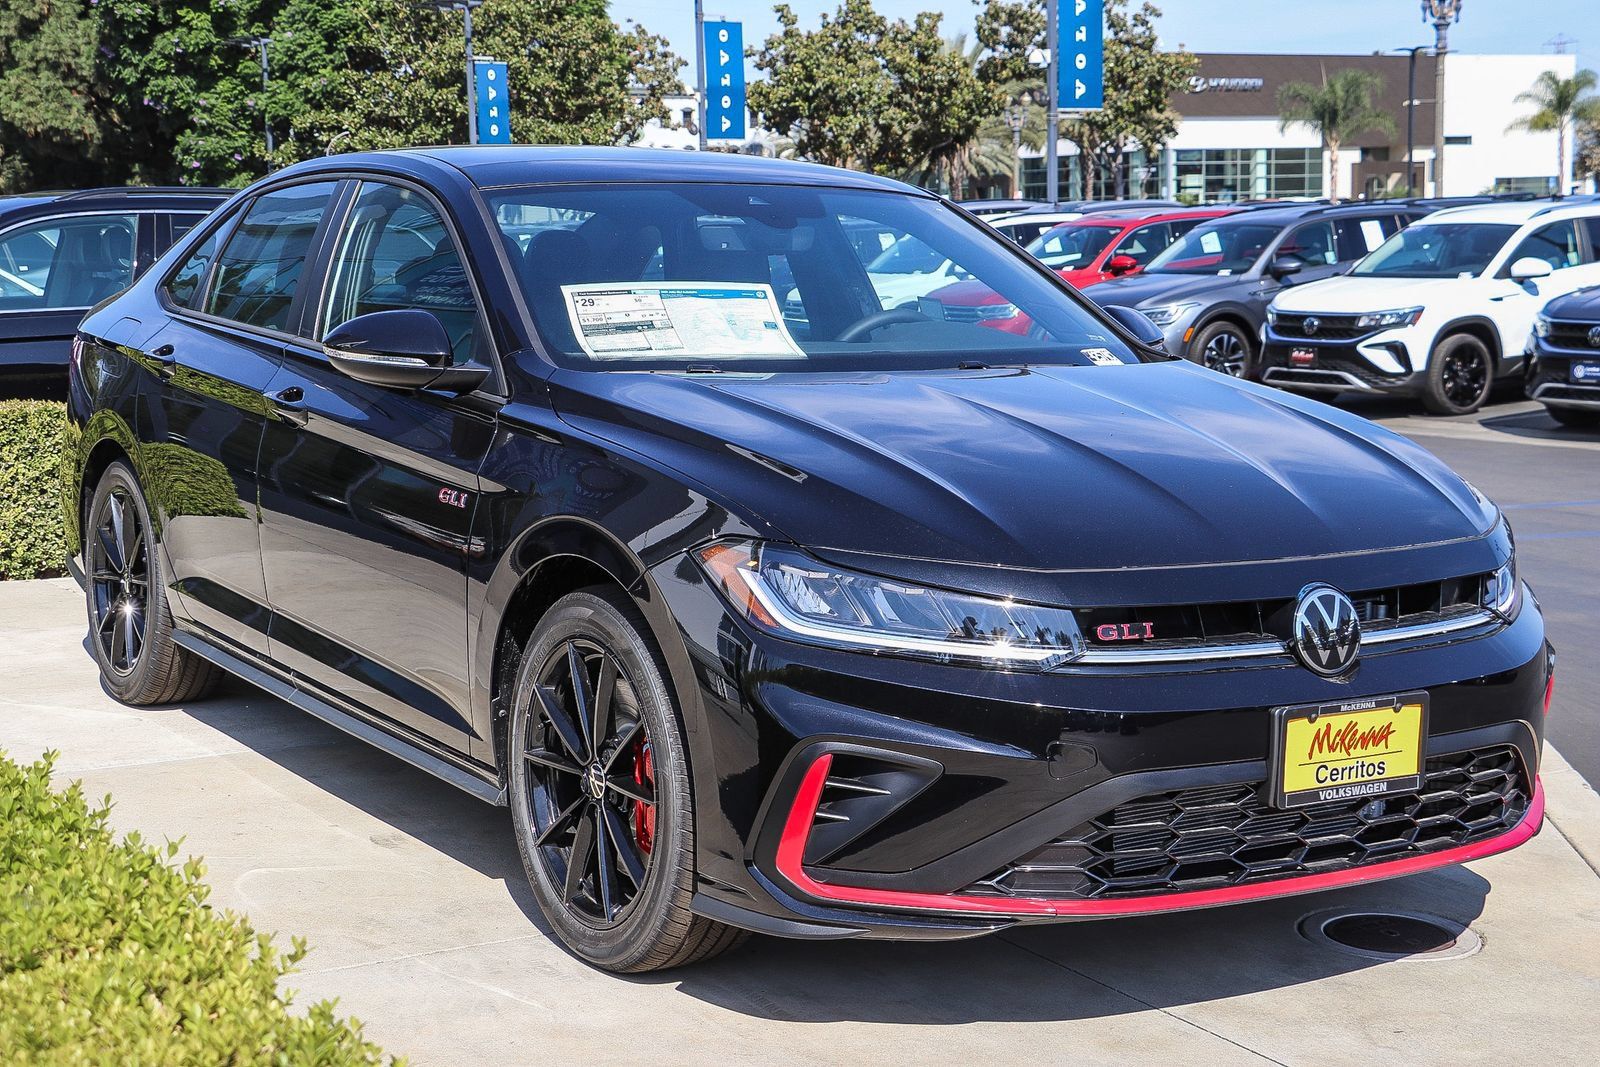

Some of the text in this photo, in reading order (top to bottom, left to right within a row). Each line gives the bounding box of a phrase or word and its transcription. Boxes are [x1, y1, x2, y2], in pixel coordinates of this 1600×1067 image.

[1074, 0, 1088, 100] VOLV
[486, 68, 500, 137] OLVO
[580, 298, 595, 307] 29
[438, 487, 468, 509] GLI
[1096, 621, 1155, 641] GLI
[1340, 701, 1376, 712] McKENNA
[1315, 760, 1386, 784] Cerritos
[1318, 781, 1388, 801] VOLKSWAGEN
